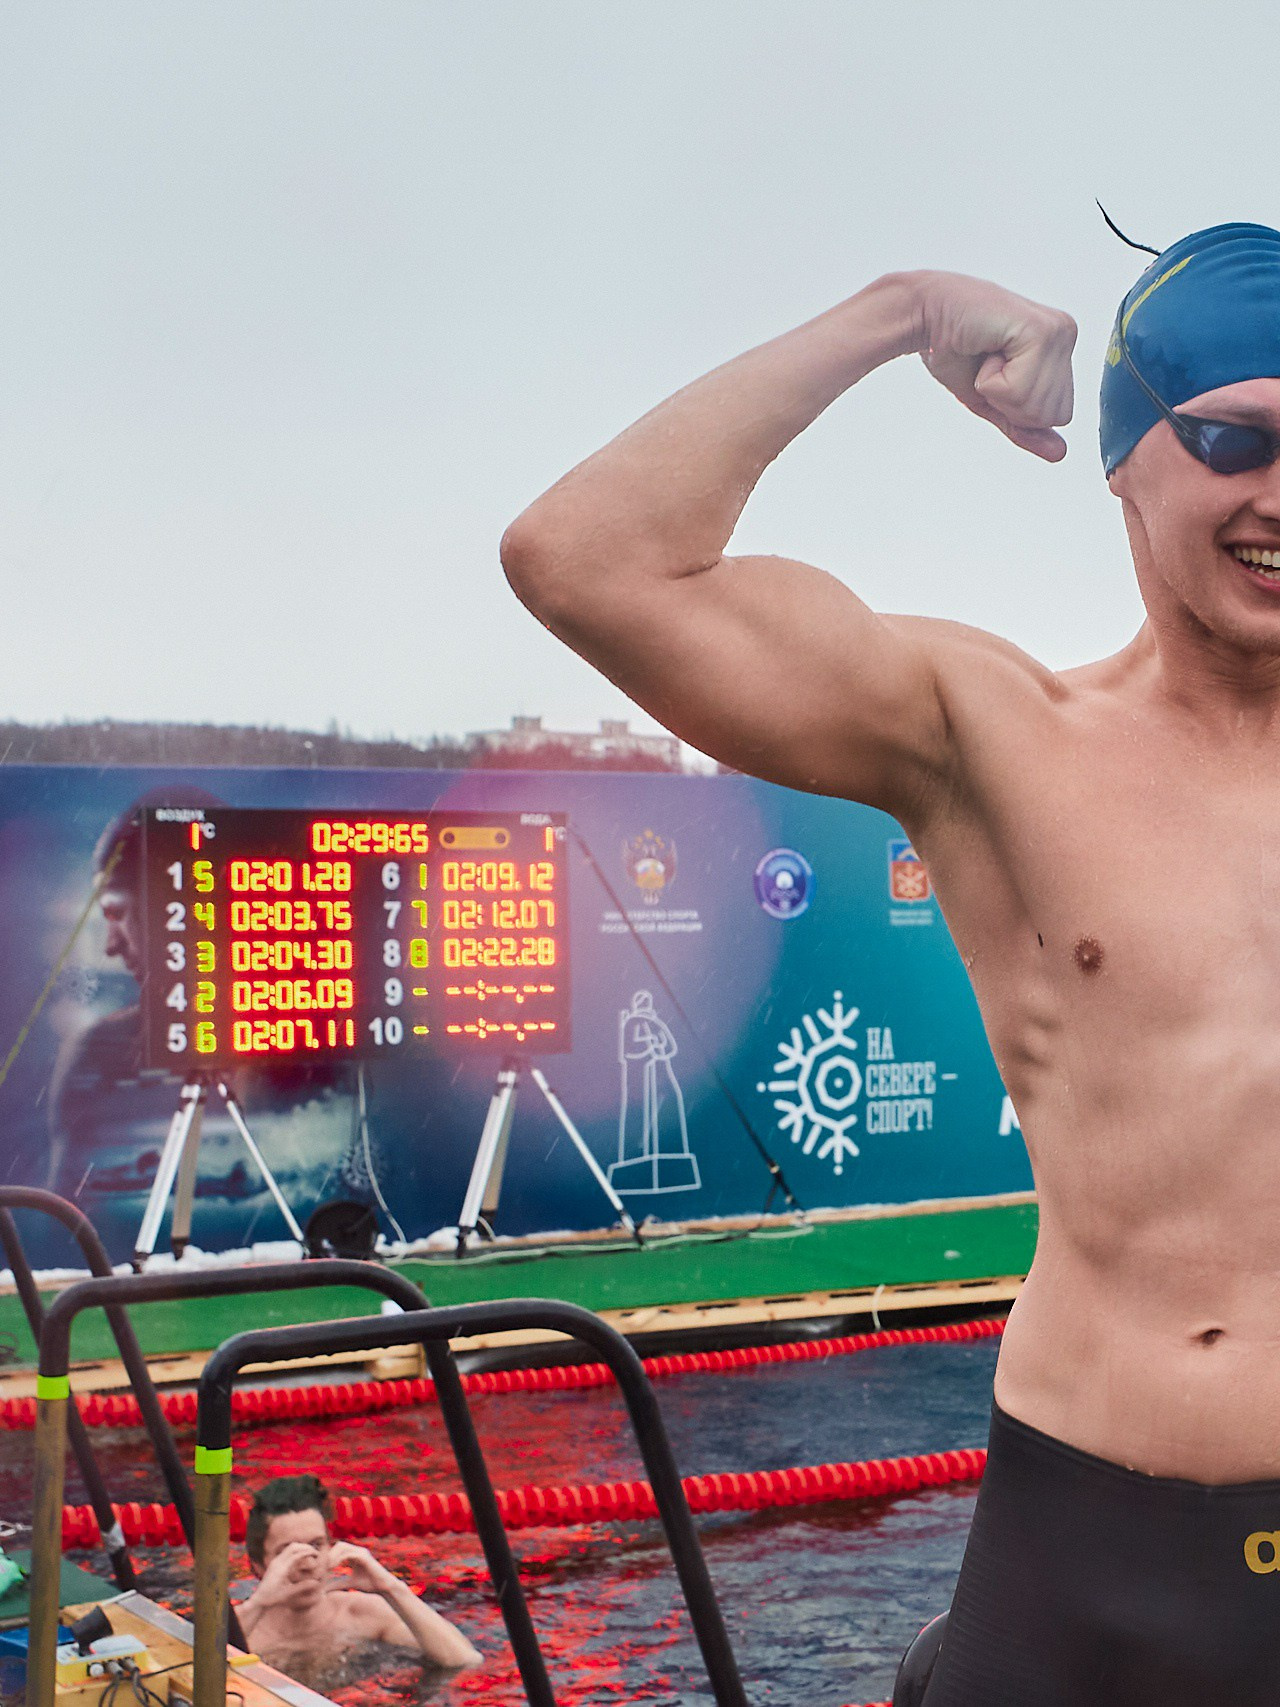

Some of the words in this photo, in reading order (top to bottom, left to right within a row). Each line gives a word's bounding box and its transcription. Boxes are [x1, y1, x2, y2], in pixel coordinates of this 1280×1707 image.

[312, 823, 429, 853] 02:29:65
[166, 861, 183, 891] 1
[192, 860, 215, 892] 5
[381, 862, 400, 890] 6
[419, 863, 428, 891] 1
[166, 901, 186, 931] 2
[193, 902, 215, 931] 4
[231, 901, 352, 932] 02:03.75
[383, 900, 402, 929] 7
[411, 900, 428, 929] 7
[166, 941, 186, 972] 3
[196, 941, 216, 972] 3
[231, 940, 352, 971] 02:04.30
[383, 938, 401, 968] 8
[409, 938, 429, 968] 8
[443, 937, 555, 967] 02:22.28
[166, 982, 188, 1012] 4
[196, 981, 216, 1013] 2
[232, 978, 353, 1011] 02:06.09
[384, 977, 403, 1006] 9
[167, 1022, 188, 1053] 5
[196, 1021, 217, 1053] 6
[368, 1016, 404, 1046] 10
[866, 1026, 895, 1061] НА
[865, 1060, 937, 1098] СЕВЕРЕ
[866, 1097, 933, 1135] СПОРТ!
